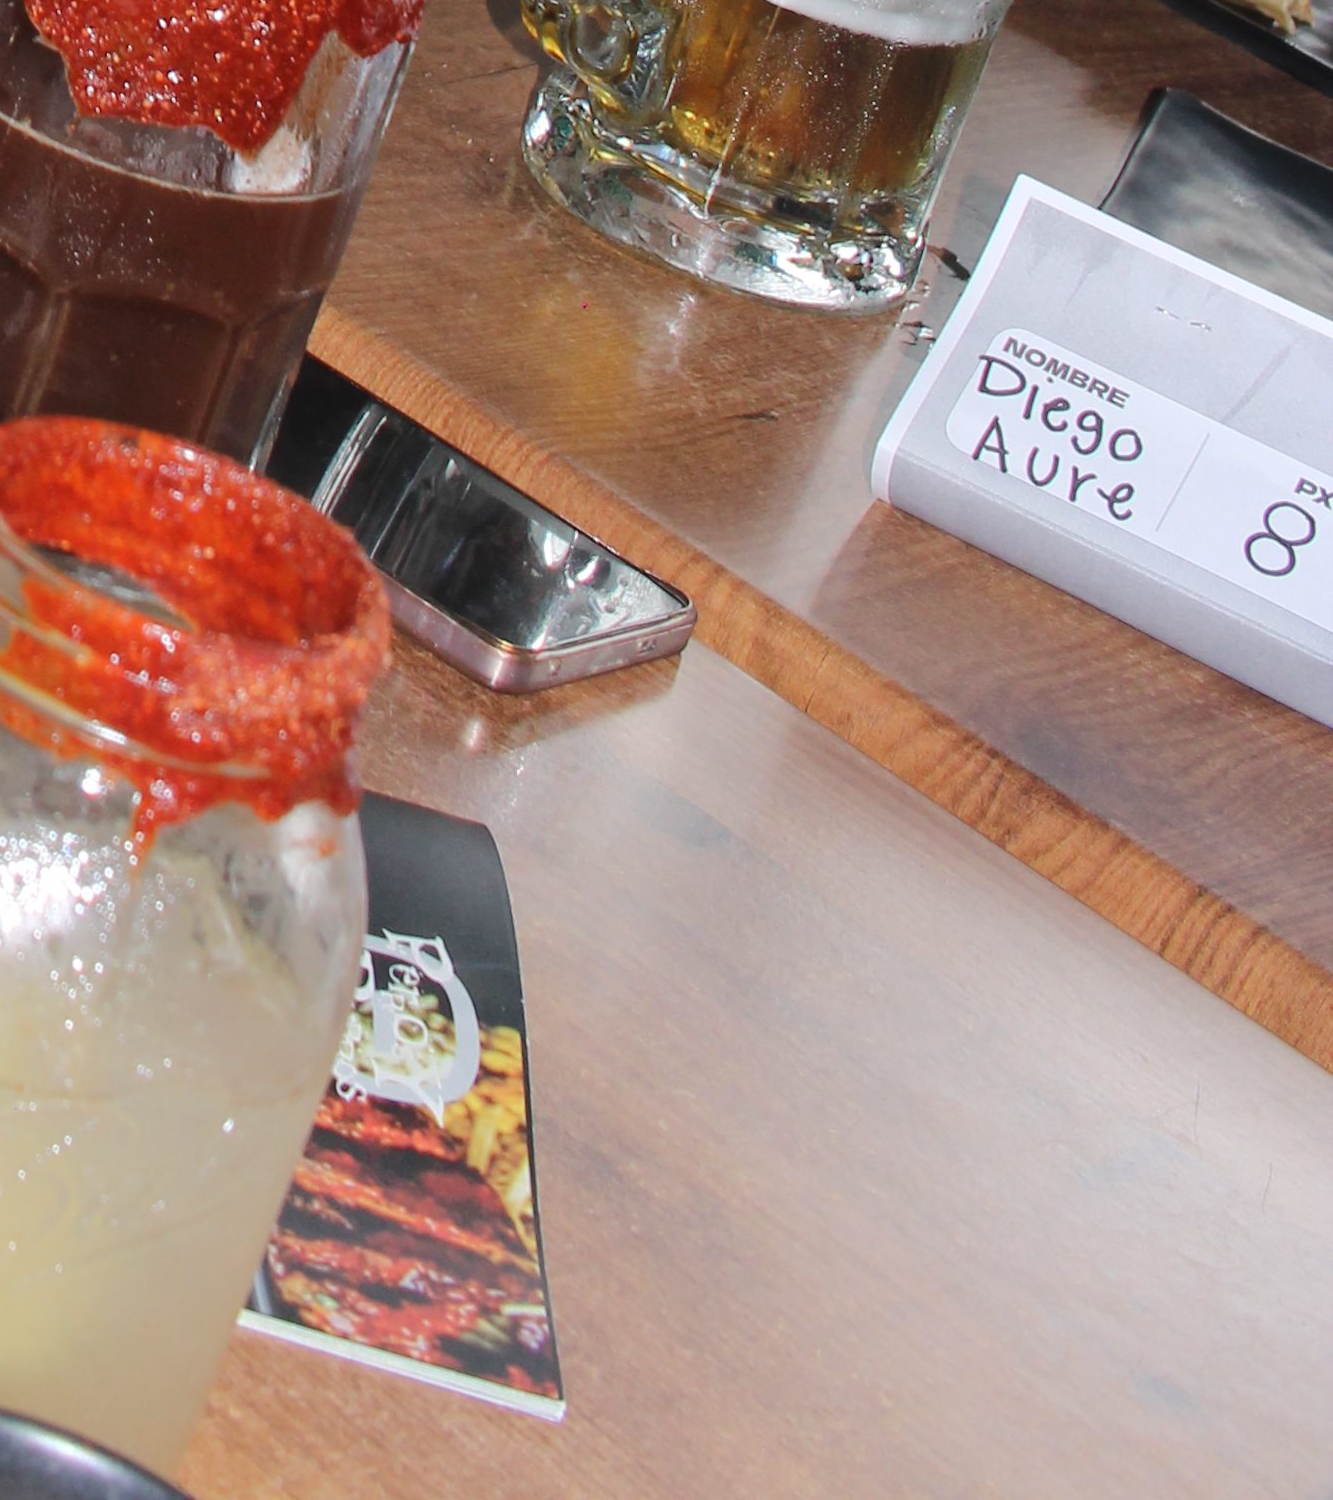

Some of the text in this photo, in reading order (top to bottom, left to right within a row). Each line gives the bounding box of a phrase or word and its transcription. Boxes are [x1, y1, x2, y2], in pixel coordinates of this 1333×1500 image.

[978, 354, 1143, 463] Diego
[1001, 335, 1131, 410] NOMBRE
[971, 415, 1134, 522] Aure
[1243, 500, 1317, 577] 8
